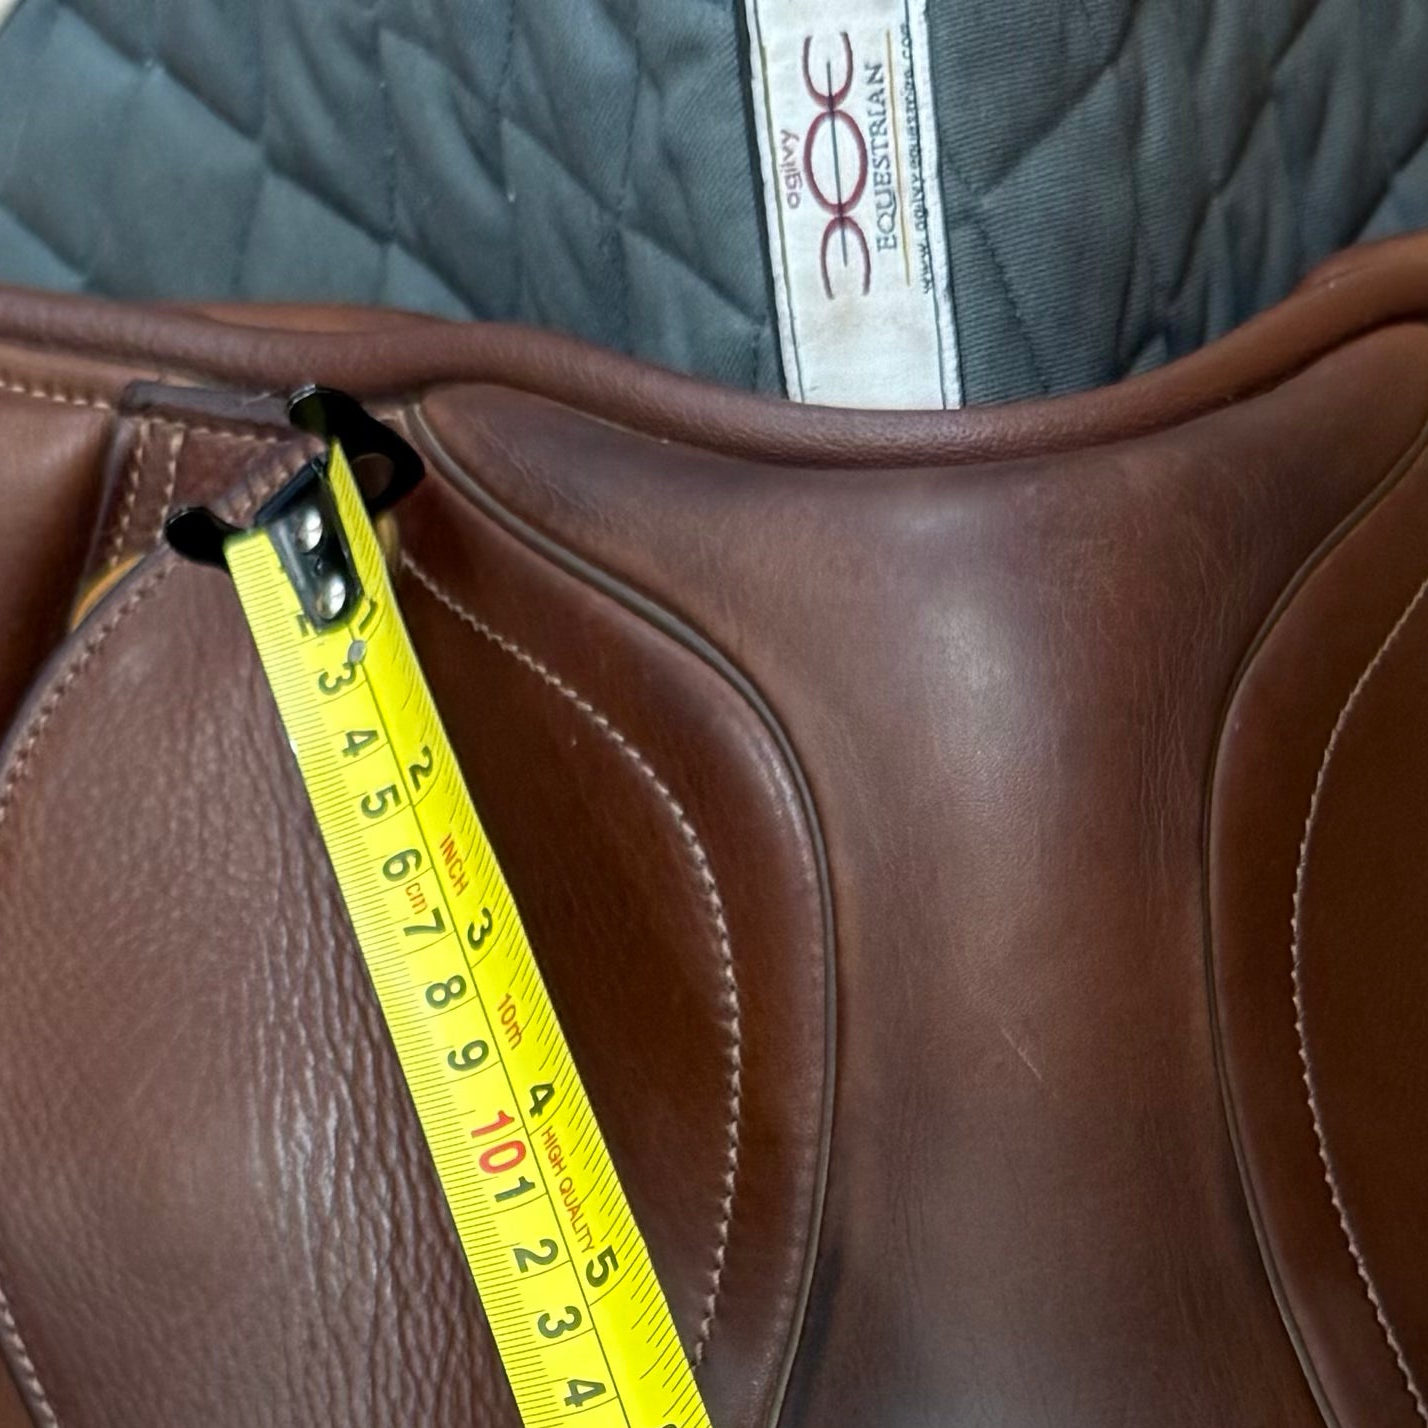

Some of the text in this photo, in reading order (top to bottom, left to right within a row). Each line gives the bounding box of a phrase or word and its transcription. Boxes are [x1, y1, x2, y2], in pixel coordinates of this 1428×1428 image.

[780, 129, 801, 209] ogilvy
[866, 63, 899, 253] EQUESTRIAN
[317, 661, 356, 696] 3
[342, 729, 378, 758] 4
[361, 784, 402, 819] 5
[382, 848, 422, 882] 6
[439, 834, 468, 896] INCH
[405, 882, 429, 914] cm
[404, 908, 446, 938] 7
[425, 974, 467, 1009] 8
[409, 745, 433, 790] 2
[467, 907, 493, 951] 3
[529, 1082, 555, 1118] 4
[586, 1246, 619, 1288] 5
[497, 994, 523, 1050] 10m
[447, 1039, 489, 1072] 9
[470, 1110, 527, 1174] 10
[493, 1176, 535, 1203] 1
[542, 1127, 596, 1253] HIGH QUALITY
[514, 1238, 558, 1273] 2
[538, 1305, 583, 1339] 3
[563, 1378, 606, 1408] 4
